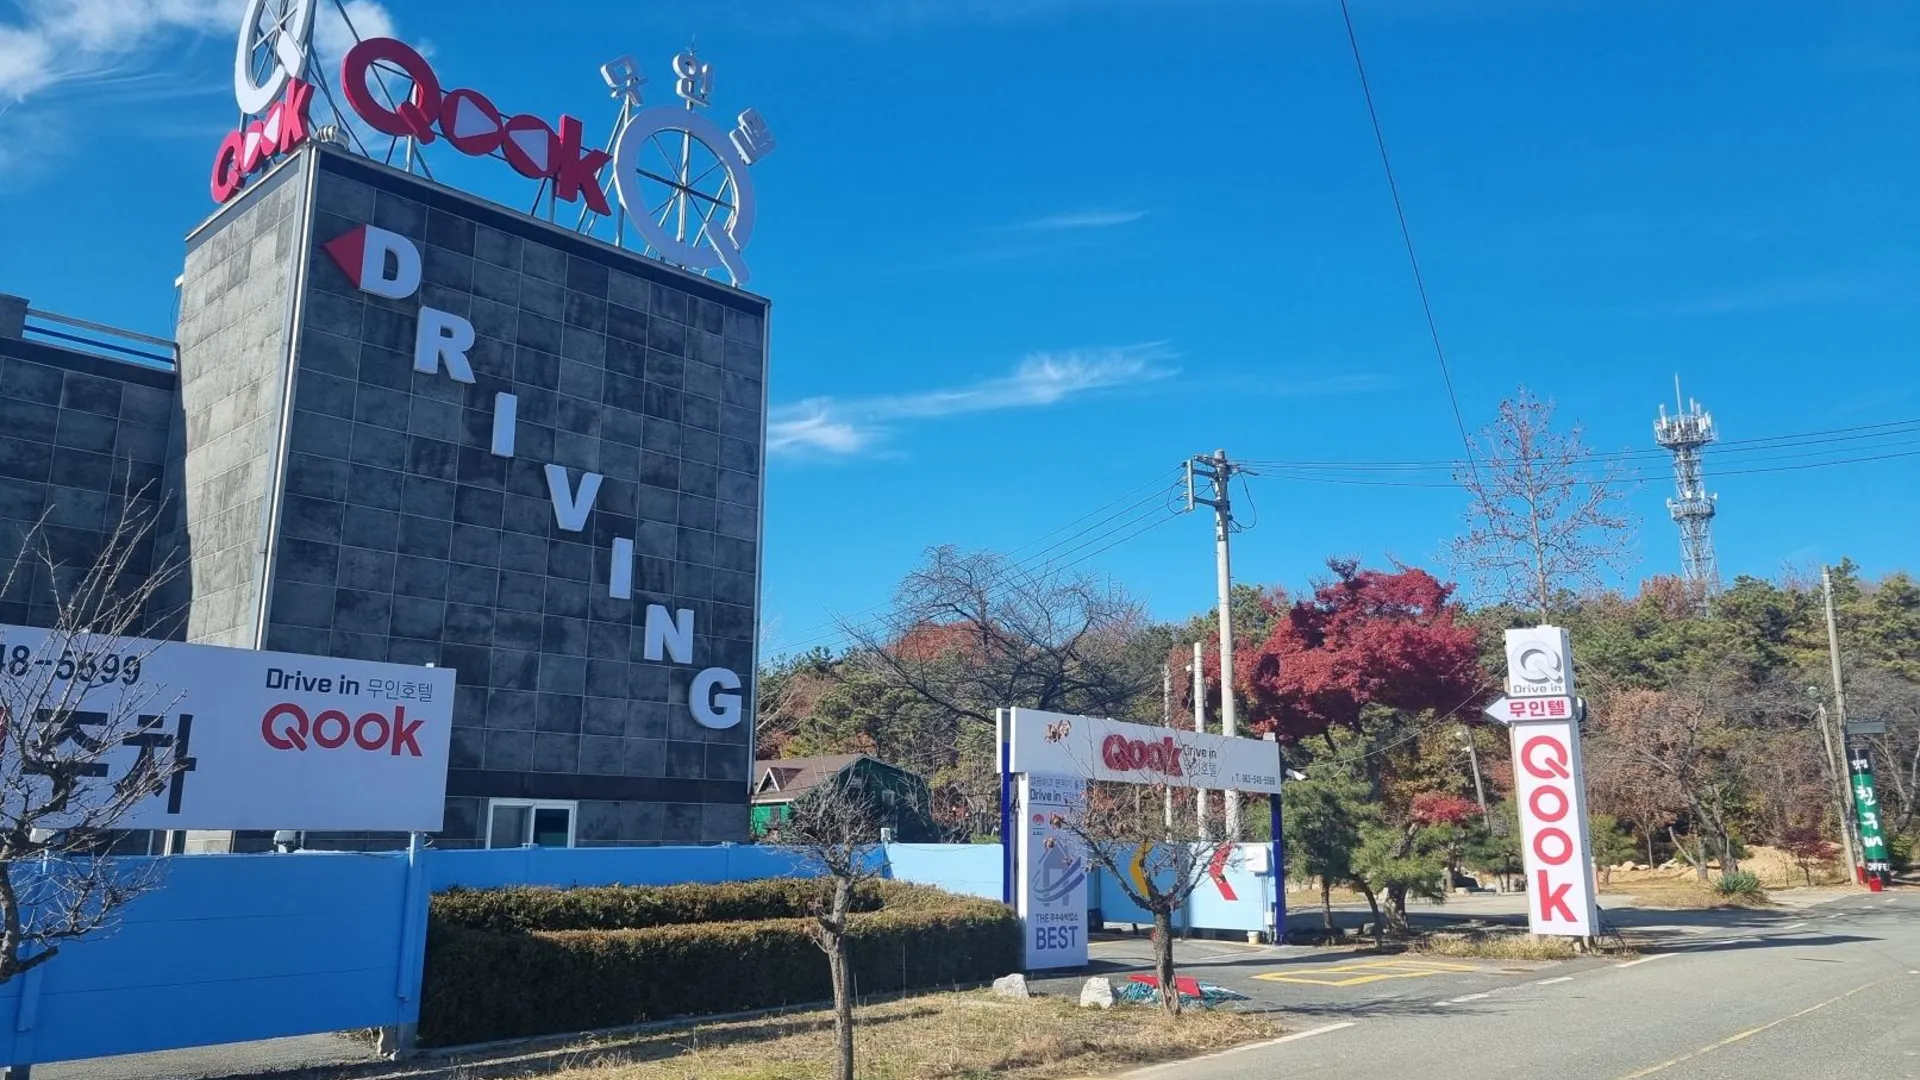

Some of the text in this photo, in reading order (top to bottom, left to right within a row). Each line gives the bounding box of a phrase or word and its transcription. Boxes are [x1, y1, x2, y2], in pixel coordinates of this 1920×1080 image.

[359, 223, 743, 729] DRIVING
[266, 668, 433, 703] Drive in 무인호텔
[1513, 684, 1562, 693] Drive in
[1510, 700, 1565, 717] 무인텔
[262, 702, 424, 757] Qook
[1030, 789, 1052, 801] Drive
[1053, 790, 1062, 801] in
[1036, 913, 1050, 923] THE
[1036, 926, 1079, 949] BEST
